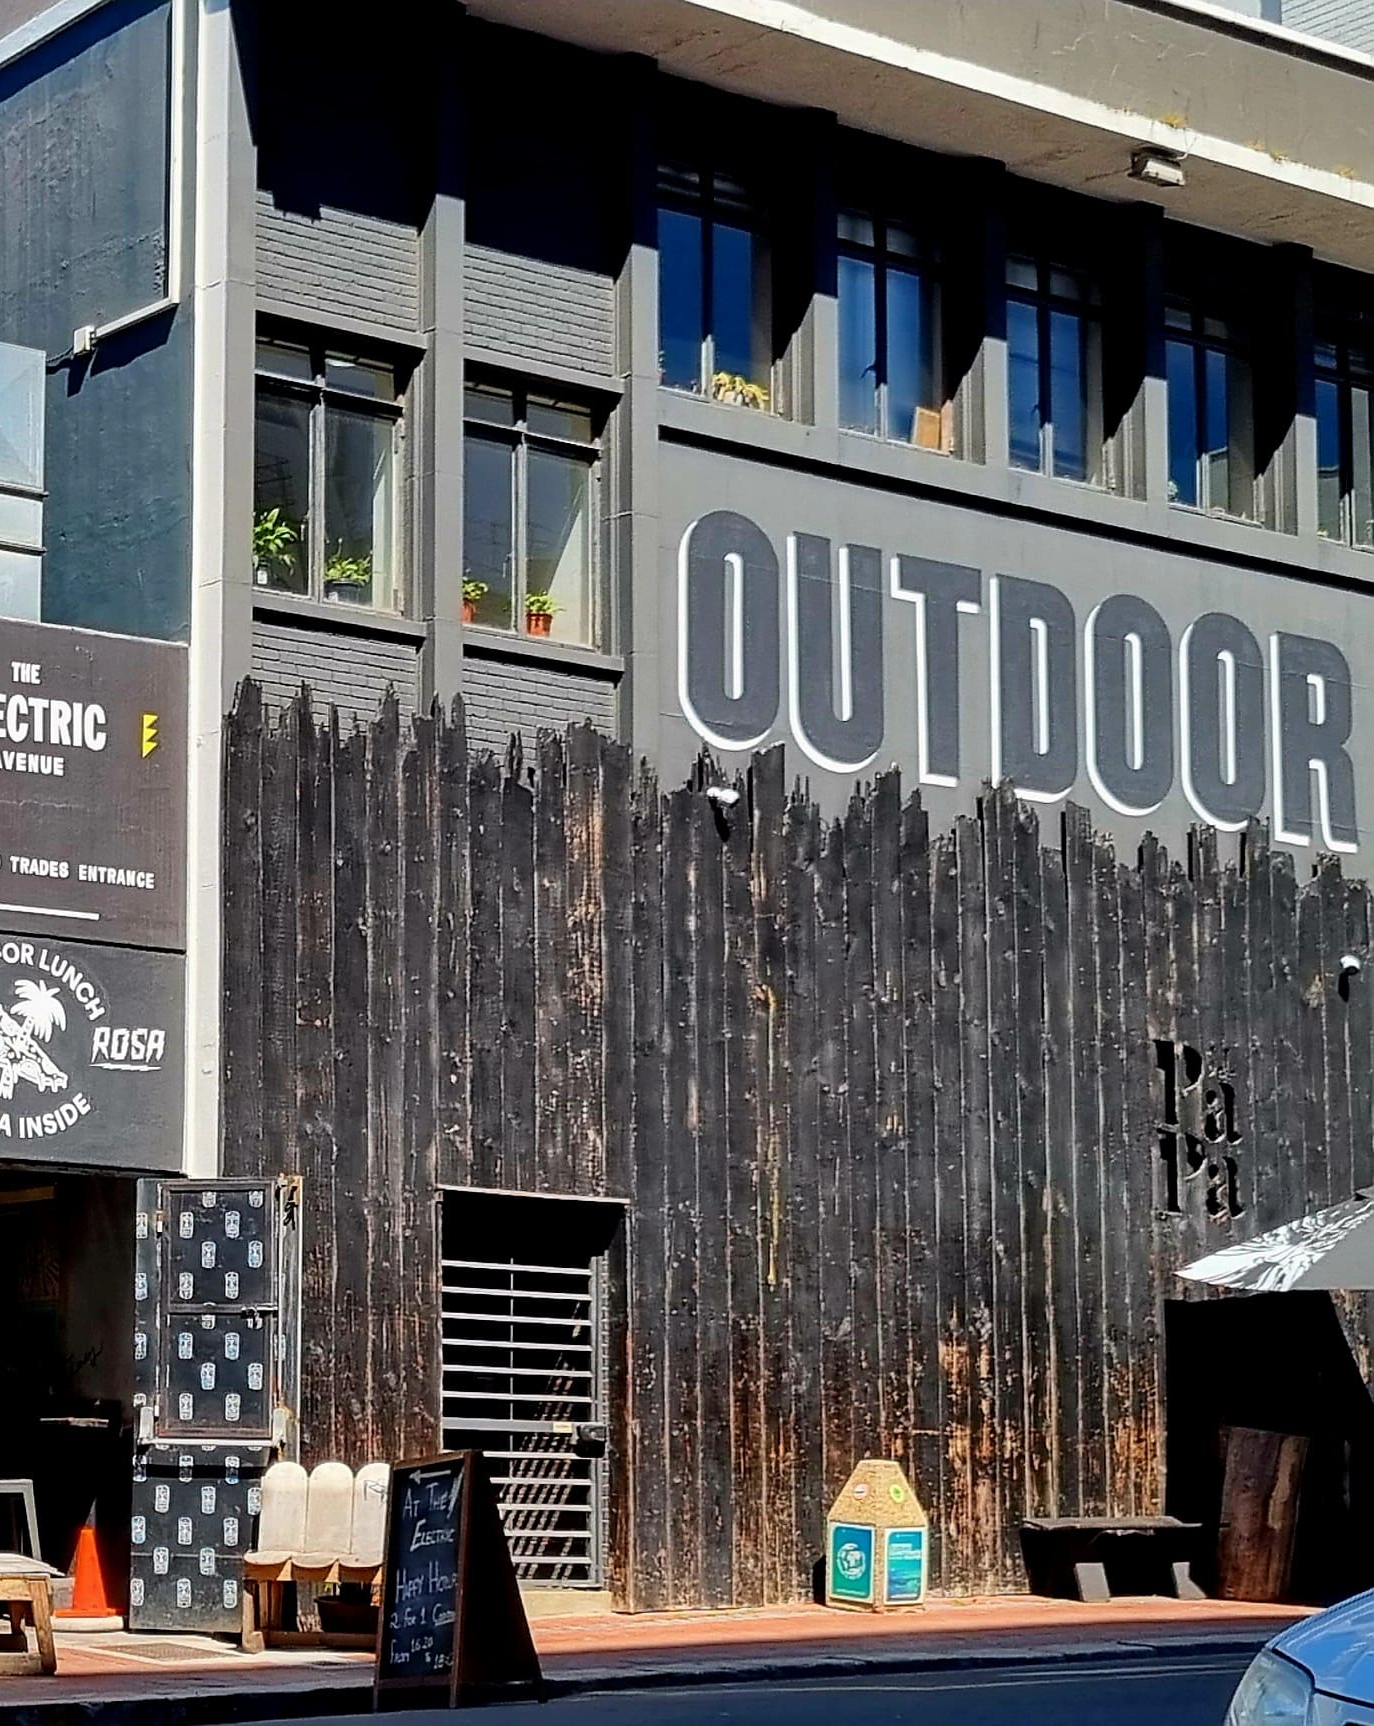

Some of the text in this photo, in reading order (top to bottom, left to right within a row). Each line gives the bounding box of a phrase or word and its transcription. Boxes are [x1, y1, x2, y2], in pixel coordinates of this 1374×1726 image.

[11, 661, 41, 685] THE
[677, 509, 1358, 853] OUTDOOR
[10, 855, 70, 879] TRADES
[78, 863, 156, 890] ENTRANCE
[39, 949, 106, 1021] LUNCH
[90, 1026, 166, 1064] ROSA
[19, 1092, 91, 1138] INSIDE
